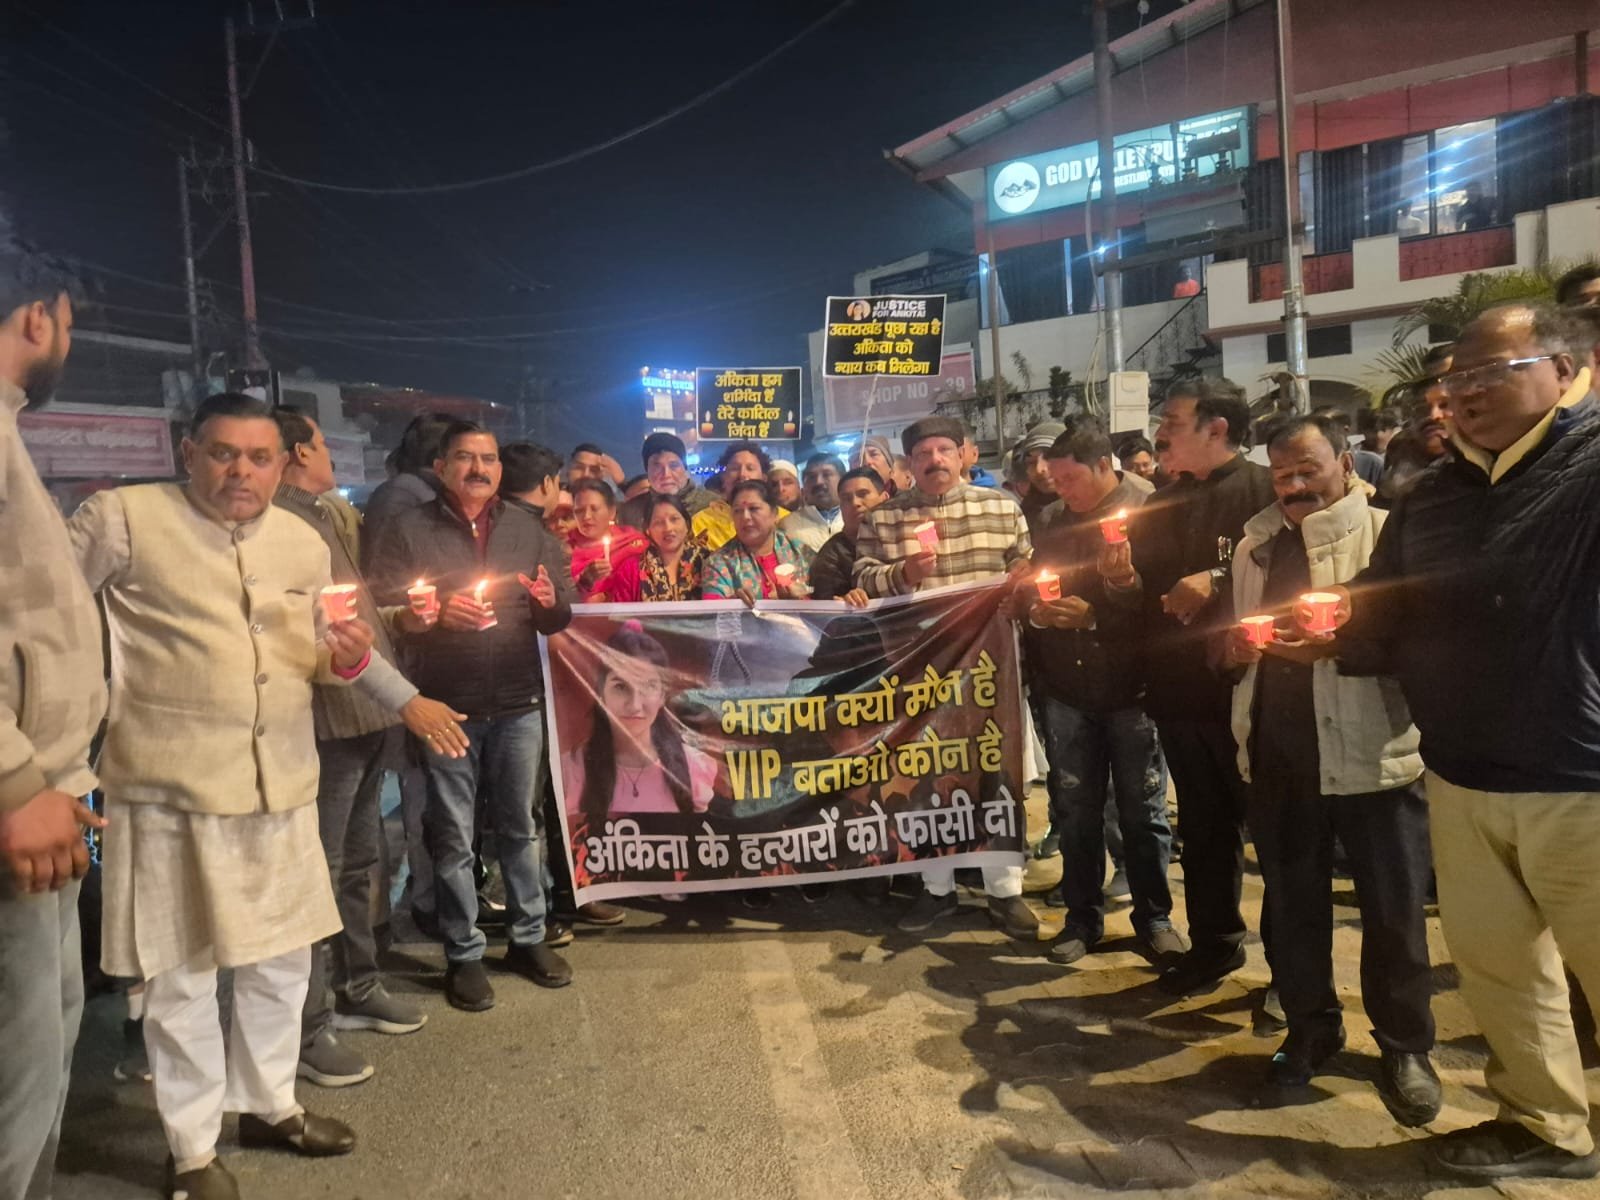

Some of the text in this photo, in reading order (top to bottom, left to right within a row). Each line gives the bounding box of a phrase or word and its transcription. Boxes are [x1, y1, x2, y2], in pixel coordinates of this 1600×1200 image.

[1045, 160, 1082, 186] GOD
[1085, 145, 1147, 179] VLEY
[872, 300, 926, 311] JUSTICE
[872, 310, 889, 318] FOR
[829, 319, 882, 337] उत्तराखंड
[909, 322, 930, 335] रहा
[930, 318, 941, 335] है
[853, 338, 914, 355] अंकिता को
[834, 357, 930, 374] न्याय कब मिलेगा
[715, 371, 783, 387] अंकिता हम
[764, 388, 775, 403] हैं
[862, 386, 902, 406] SHOP
[907, 382, 928, 399] NO
[717, 404, 781, 420] तेरे कातिल
[727, 421, 770, 438] जिंदा हैं
[721, 650, 997, 735] भाजपा क्यों मौन है
[725, 719, 1003, 800] VIP बताओ कौन है
[585, 784, 1018, 874] अंकिता के हत्यारों को फांसी दो
